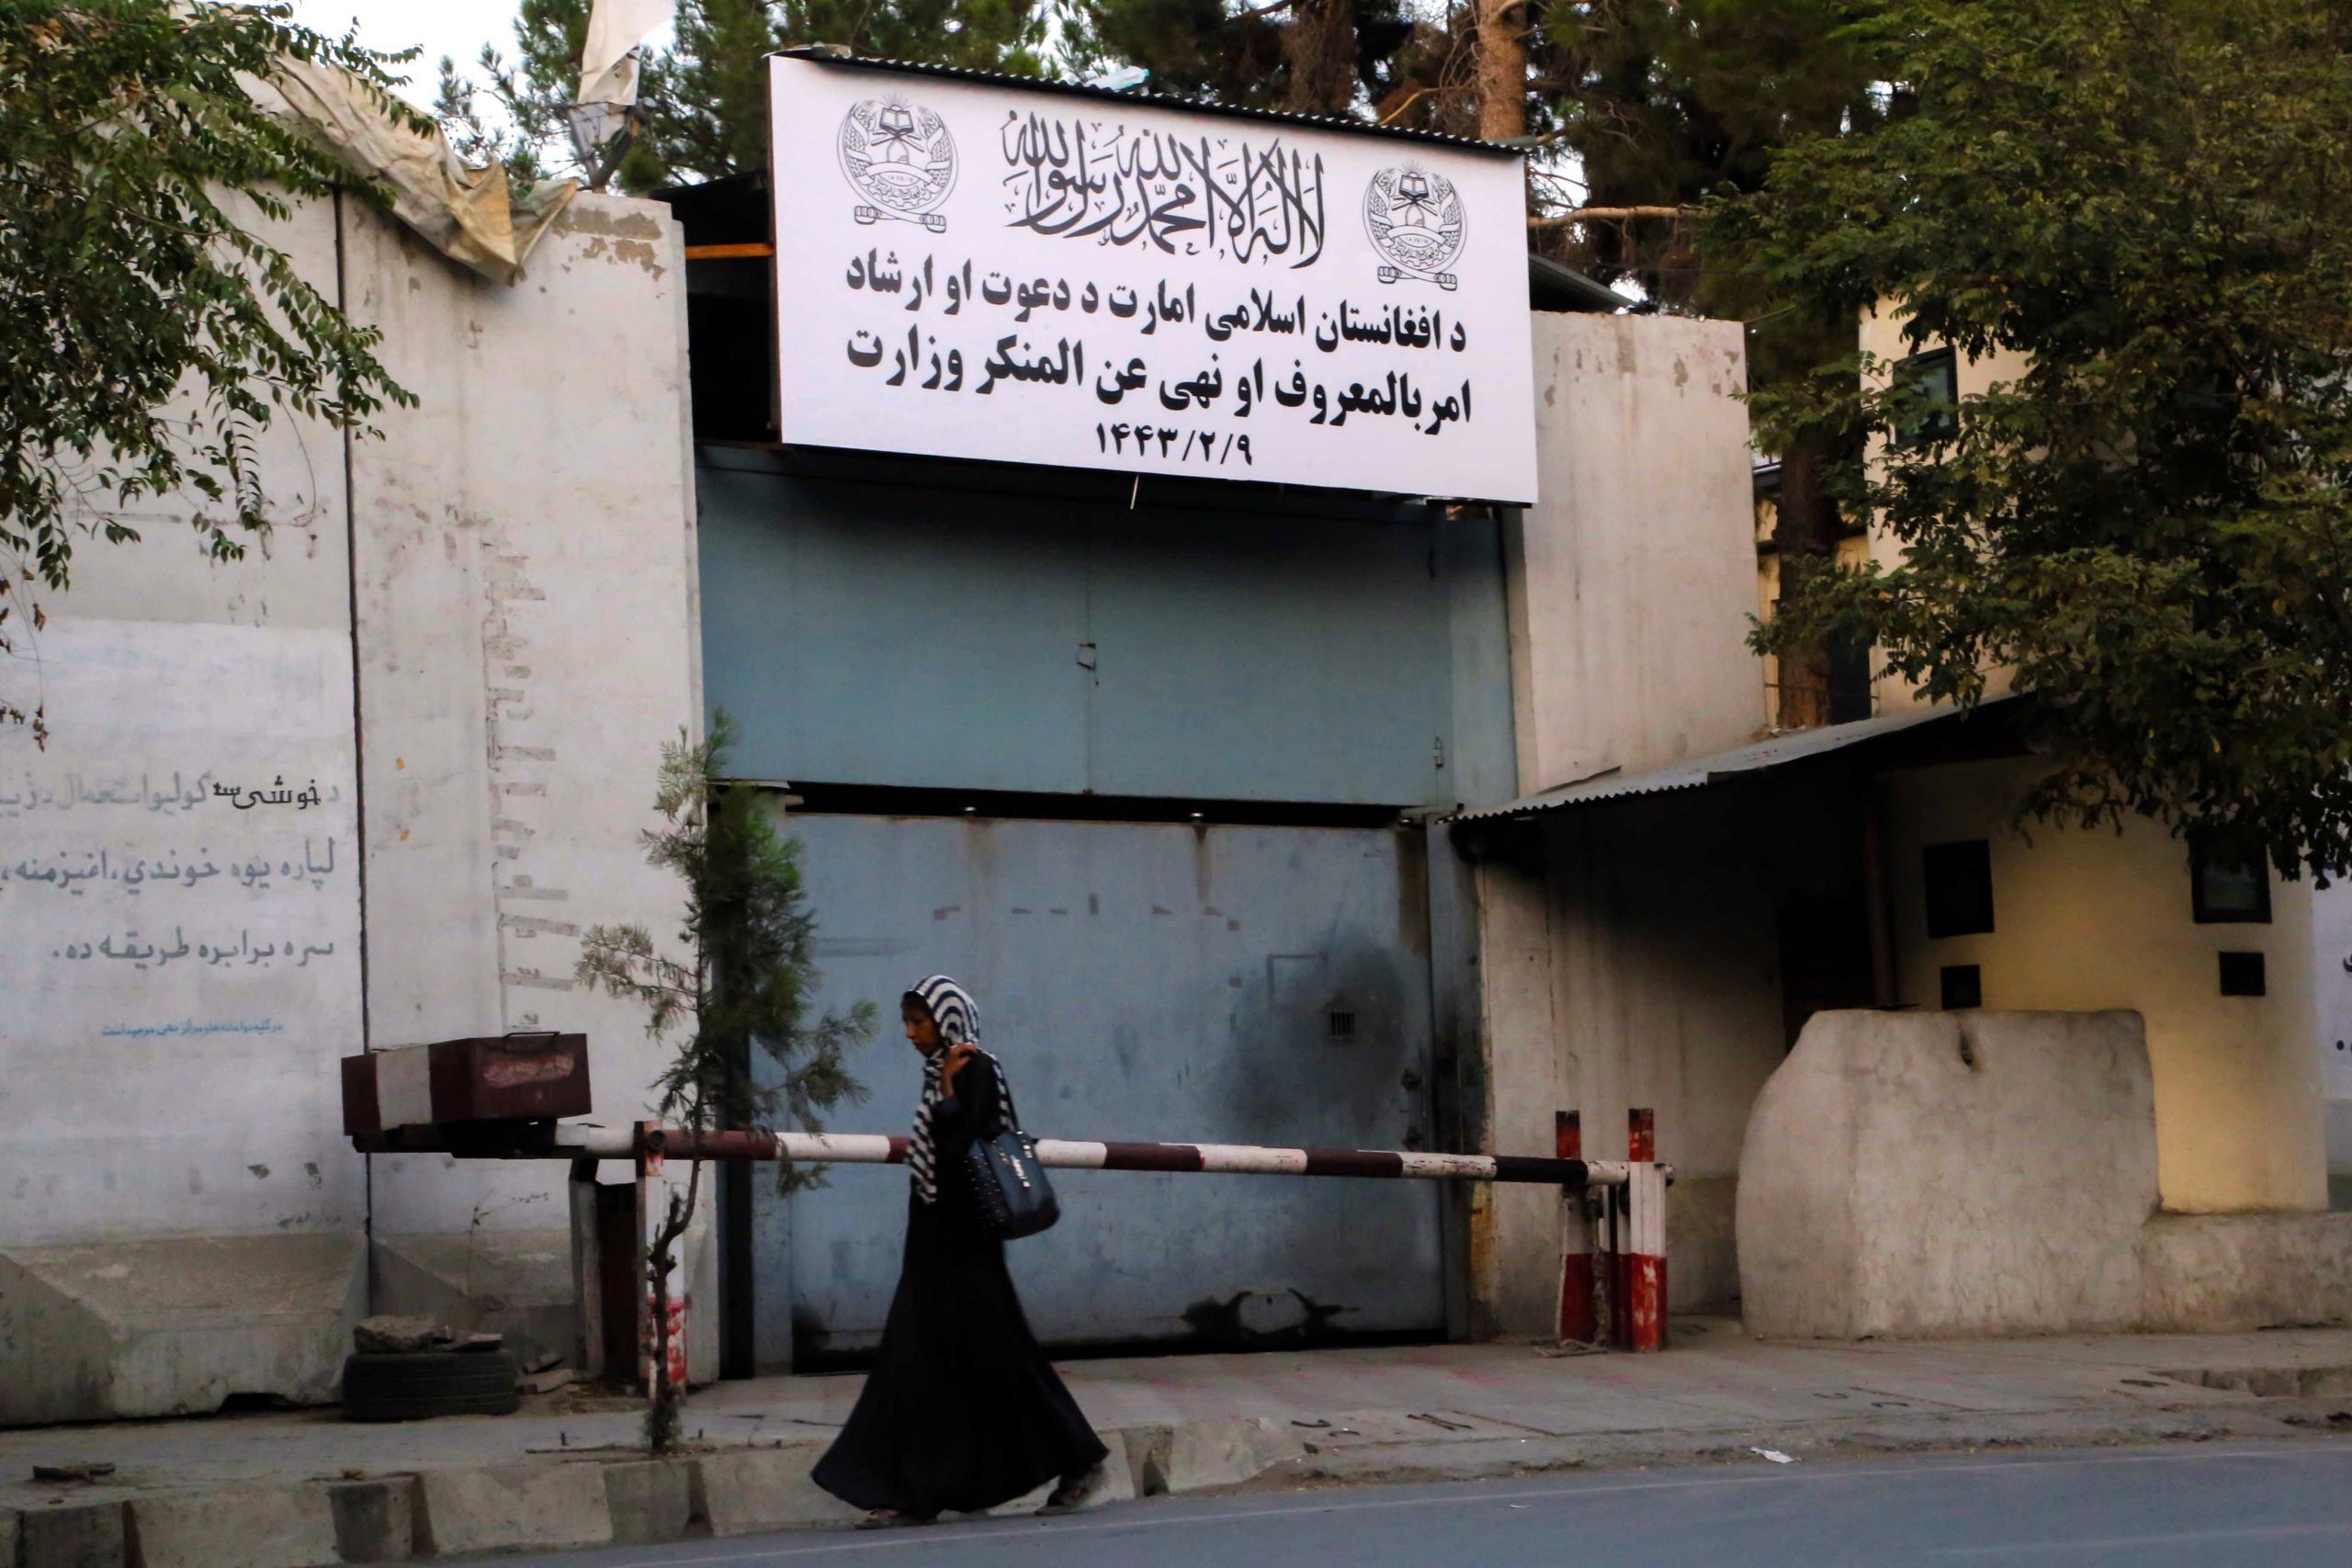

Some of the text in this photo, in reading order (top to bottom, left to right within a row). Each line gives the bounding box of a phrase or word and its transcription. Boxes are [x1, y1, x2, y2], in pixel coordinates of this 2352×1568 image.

[846, 247, 1466, 353] د افغانستان اسلامی امارت د دعوت او ارشاد
[847, 323, 964, 392] وزارت
[1096, 357, 1148, 405] عن
[1159, 353, 1223, 411] نهی
[1234, 357, 1263, 418] او
